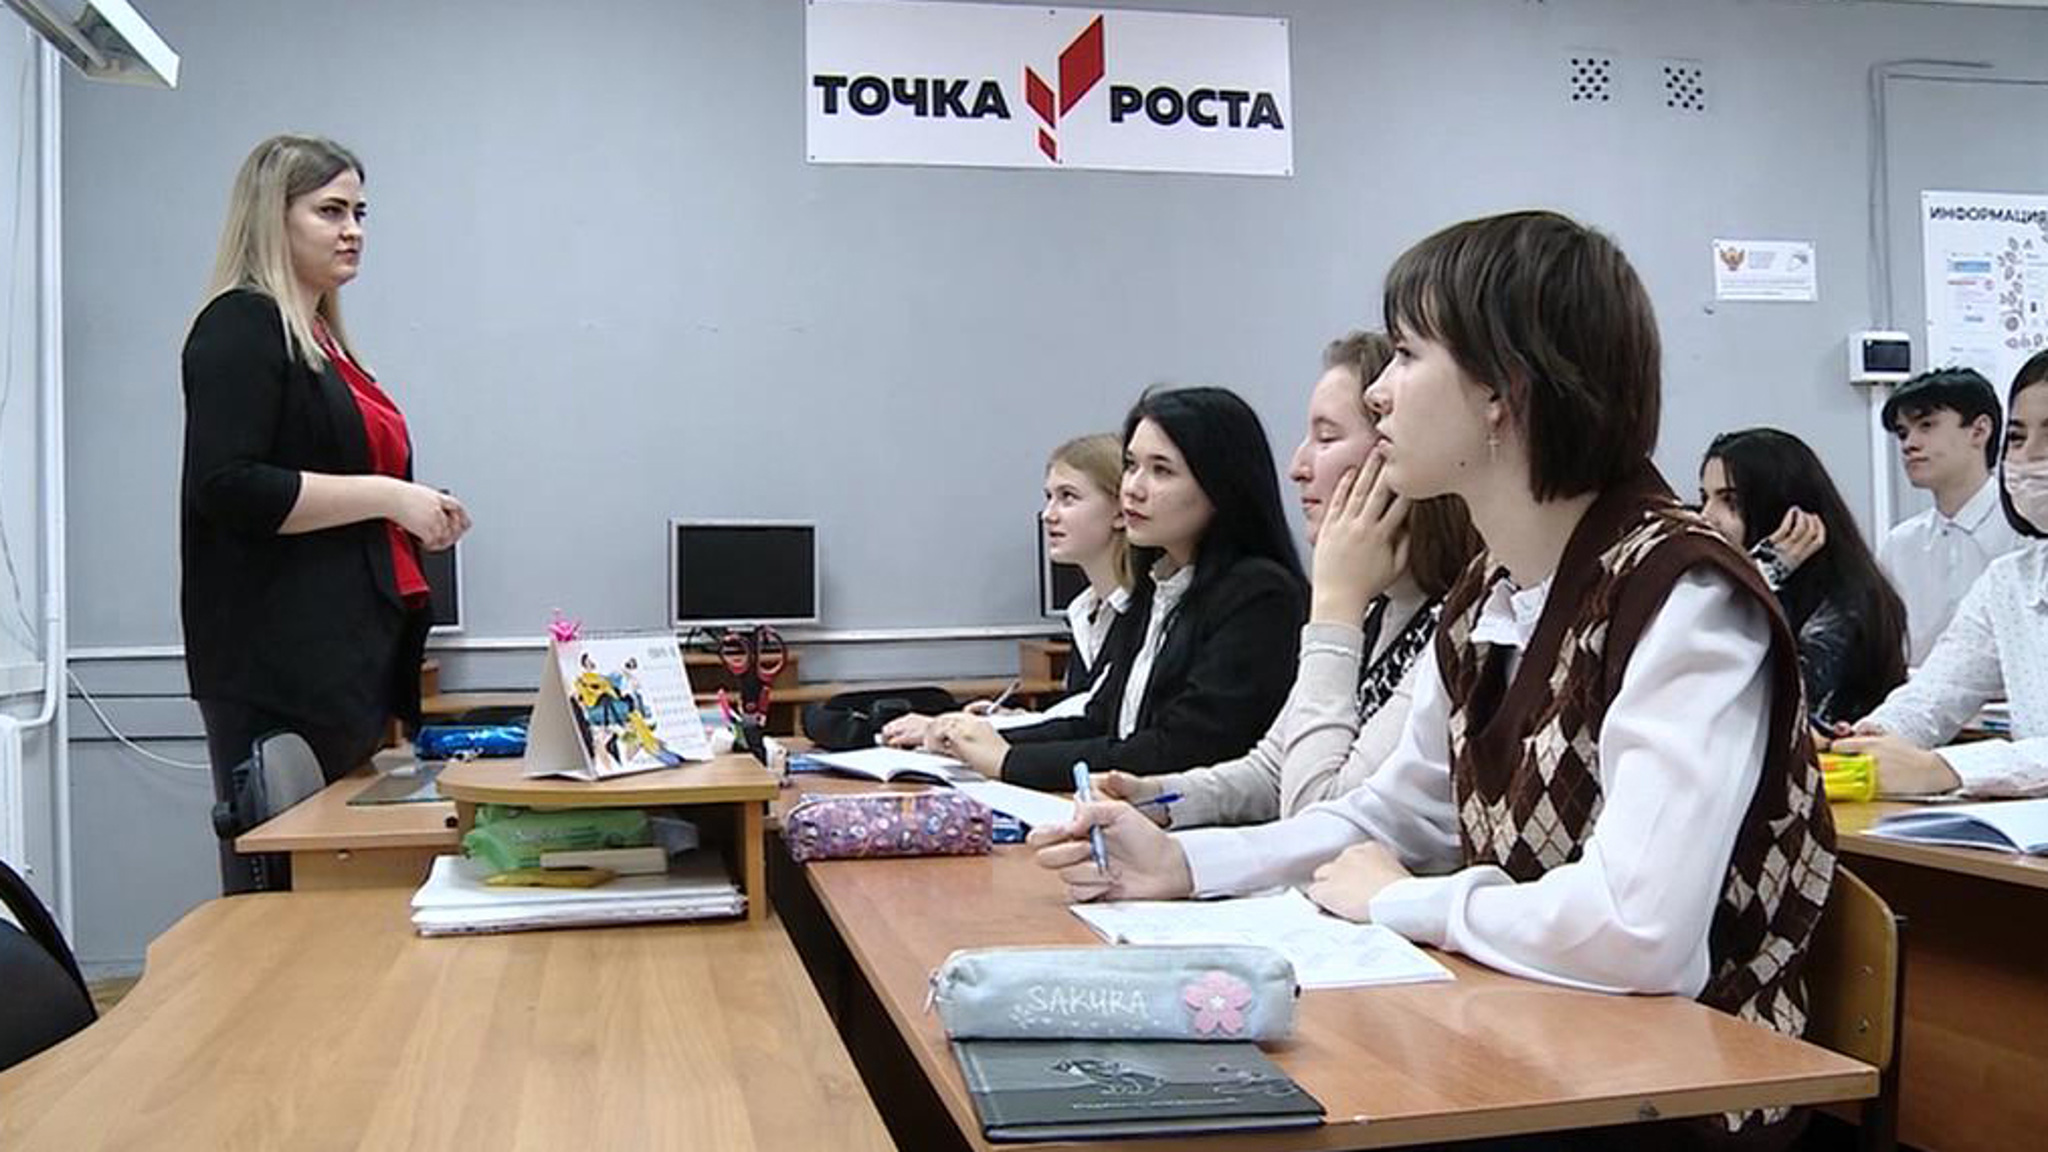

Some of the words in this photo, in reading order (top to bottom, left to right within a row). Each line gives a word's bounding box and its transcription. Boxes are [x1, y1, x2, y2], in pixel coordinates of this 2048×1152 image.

[814, 75, 1011, 119] ТОЧКА
[1110, 85, 1284, 129] РОСТА
[1027, 985, 1149, 1018] SAKURA
